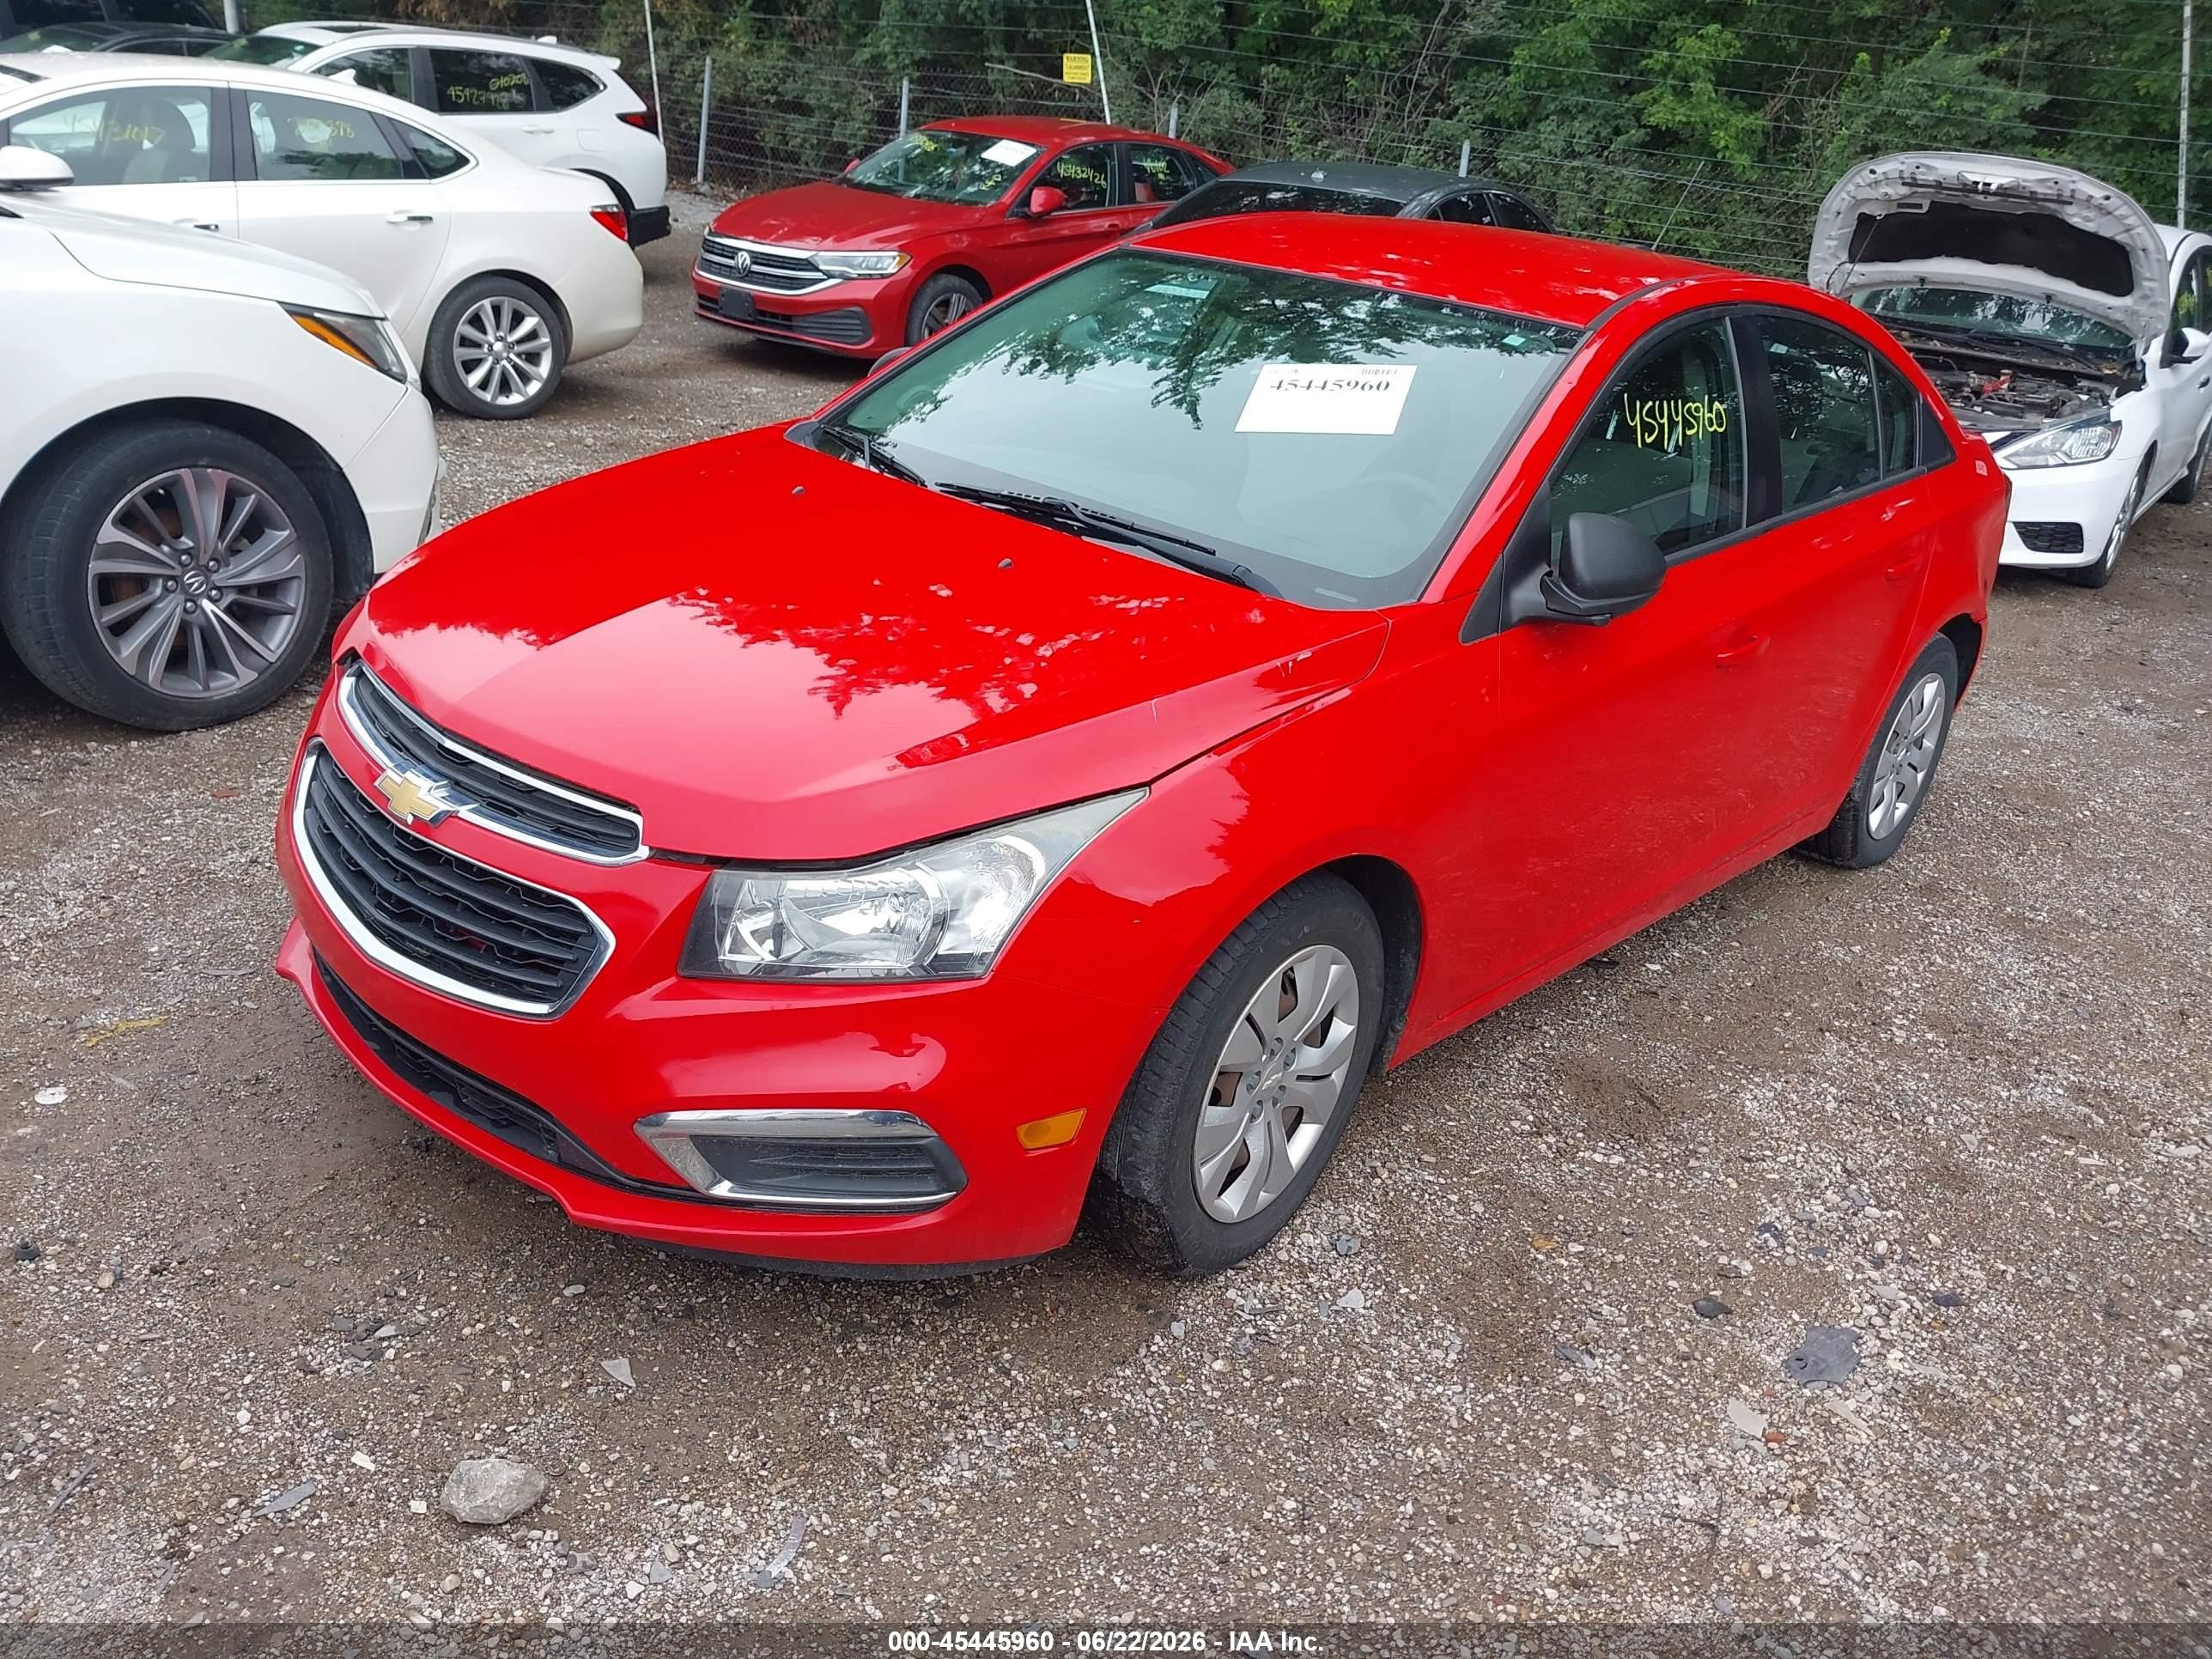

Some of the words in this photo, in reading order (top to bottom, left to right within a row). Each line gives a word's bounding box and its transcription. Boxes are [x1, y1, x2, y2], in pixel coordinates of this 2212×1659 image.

[1057, 161, 1107, 188] 45432426
[1270, 380, 1390, 392] 45445960
[1624, 392, 1727, 450] 45445960
